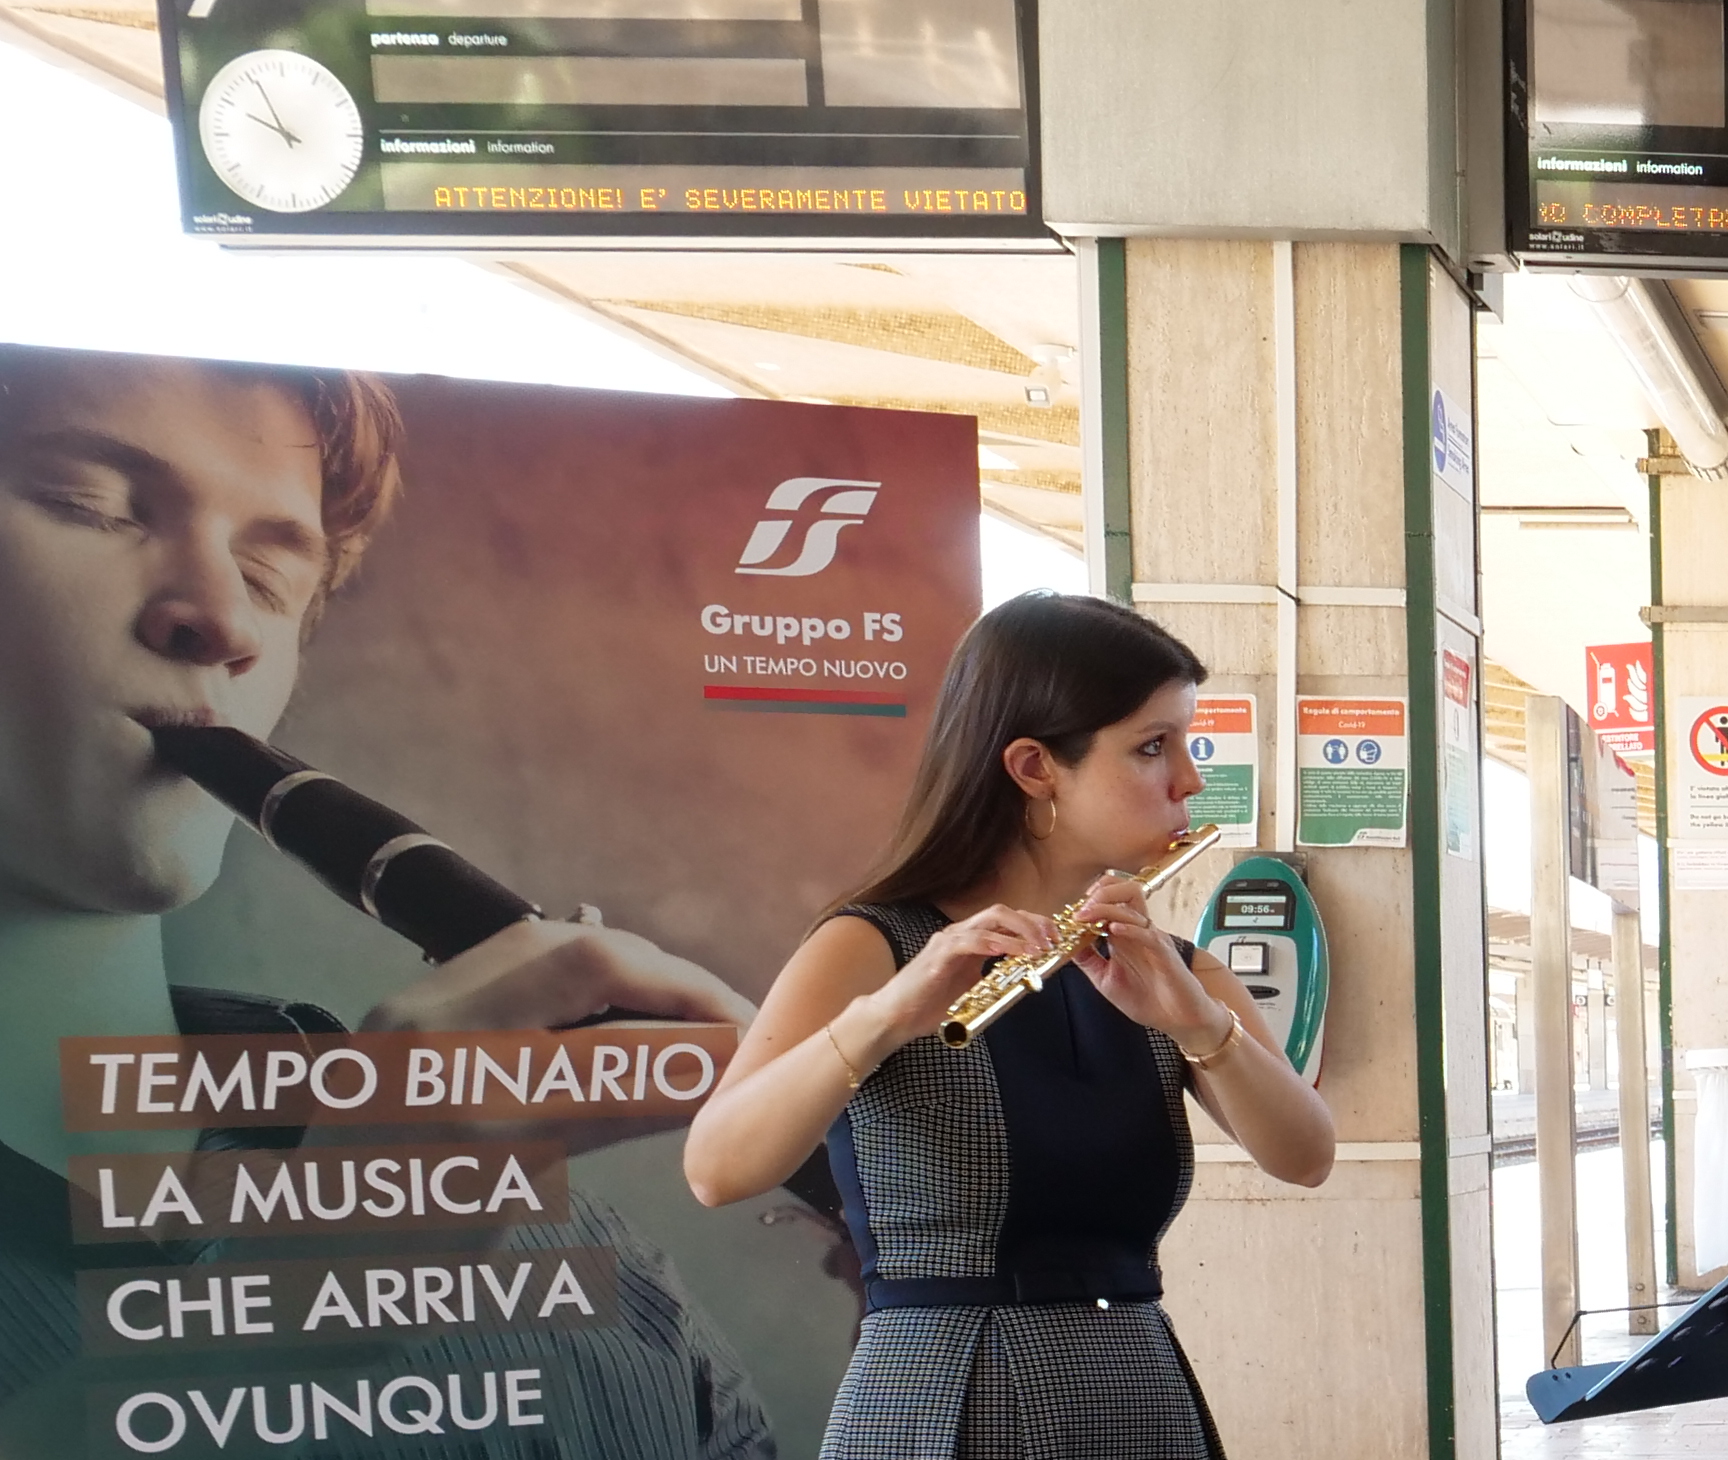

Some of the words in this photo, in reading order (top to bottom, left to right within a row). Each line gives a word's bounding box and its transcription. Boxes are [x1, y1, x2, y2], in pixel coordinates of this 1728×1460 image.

[371, 32, 439, 47] partenza
[448, 33, 508, 48] departure
[380, 139, 476, 154] informazioni
[487, 141, 554, 155] information
[1537, 157, 1627, 173] informazioni
[1636, 161, 1703, 176] information
[434, 187, 623, 209] ATTENZIONE!
[685, 189, 887, 211] SEVERAMENTE
[904, 190, 1026, 212] VIETATO
[701, 604, 850, 646] Gruppo
[863, 612, 904, 642] FS
[704, 655, 738, 674] UN
[743, 656, 817, 677] TEMPO
[823, 660, 908, 681] NUOVO
[1241, 904, 1271, 914] 09:56
[90, 1046, 378, 1114] TEMPO
[404, 1042, 716, 1107] BINARIO
[98, 1165, 203, 1229] LA
[229, 1154, 544, 1225] MUSICA
[105, 1273, 275, 1343] CHE
[301, 1261, 597, 1331] ARRIVA
[115, 1368, 545, 1454] OVUNQUE
